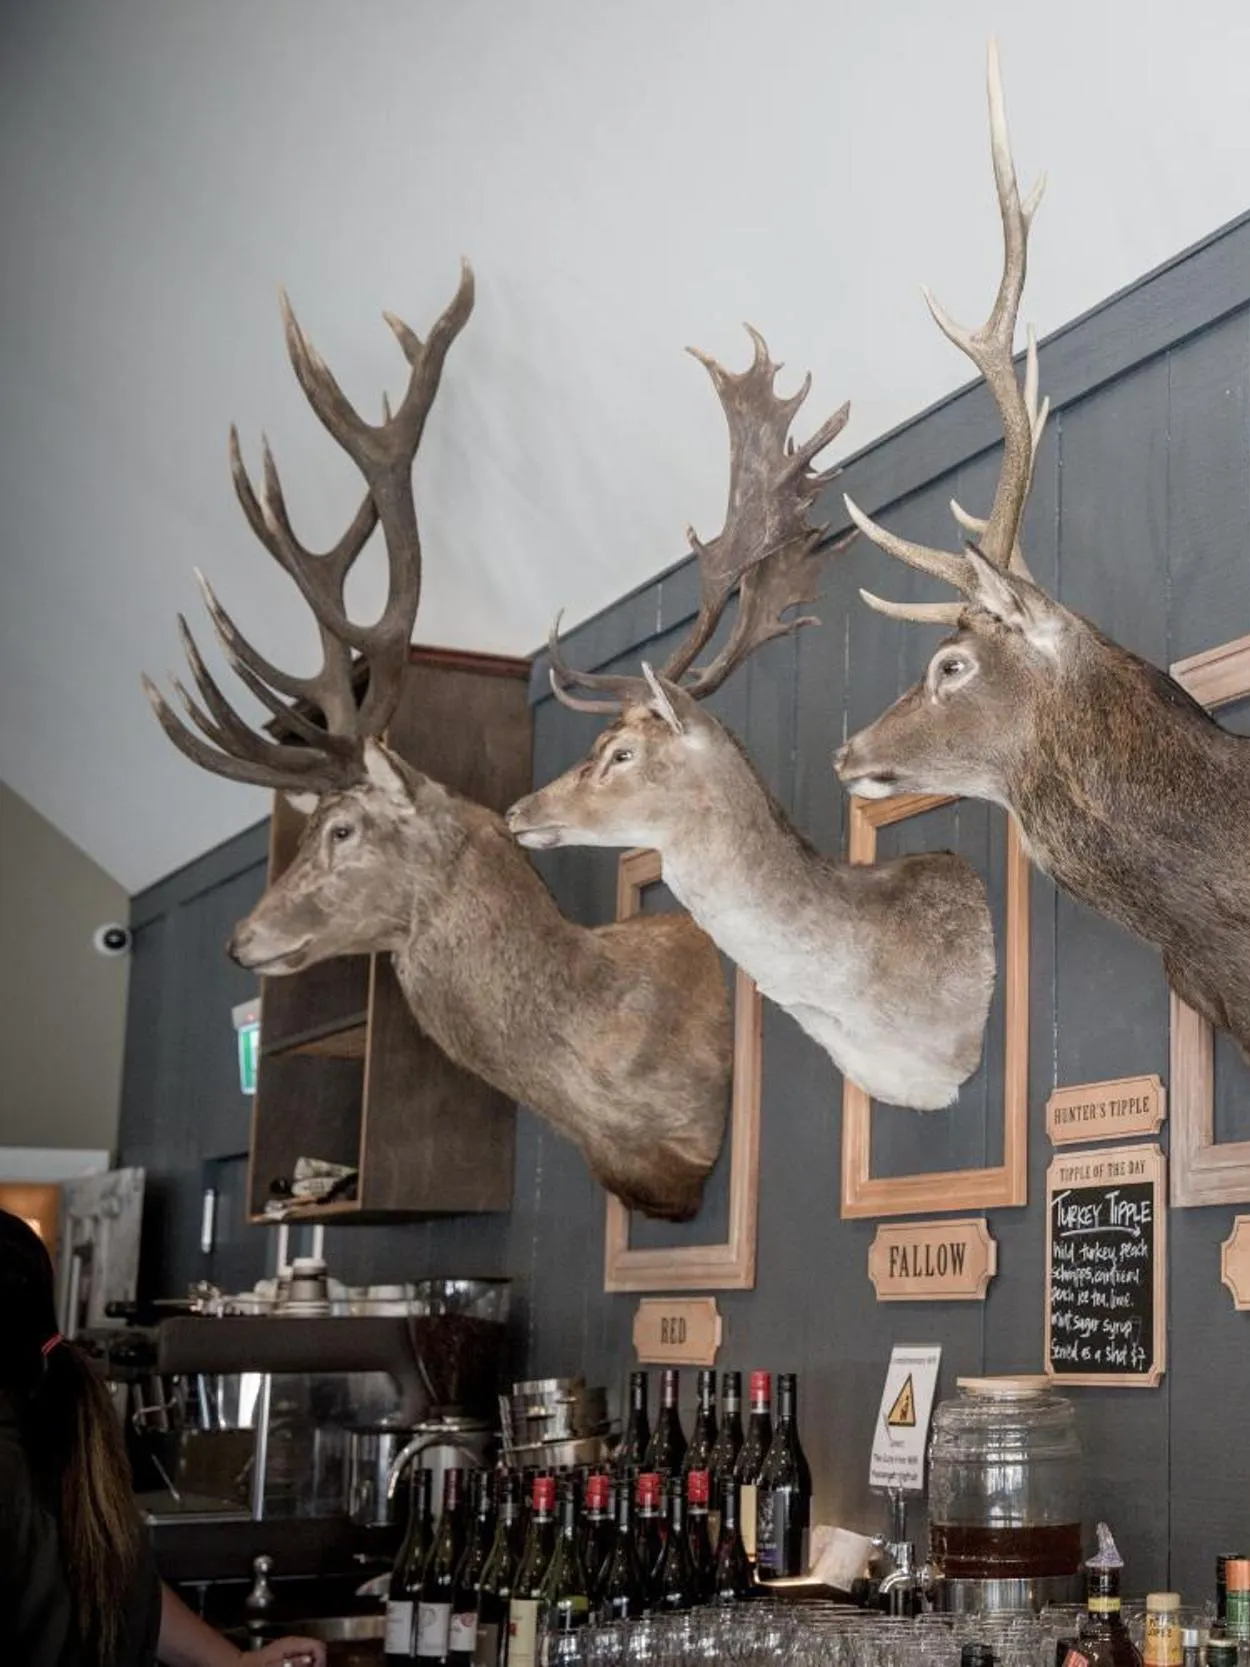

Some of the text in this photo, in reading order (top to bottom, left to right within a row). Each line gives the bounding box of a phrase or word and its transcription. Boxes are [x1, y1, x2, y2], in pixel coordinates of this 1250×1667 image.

[1054, 1096, 1150, 1125] HUNTER'S TIPPLE
[1060, 1159, 1147, 1182] TIPPLE OF THE DAY
[889, 1242, 966, 1279] FALLOW
[660, 1317, 687, 1346] RED
